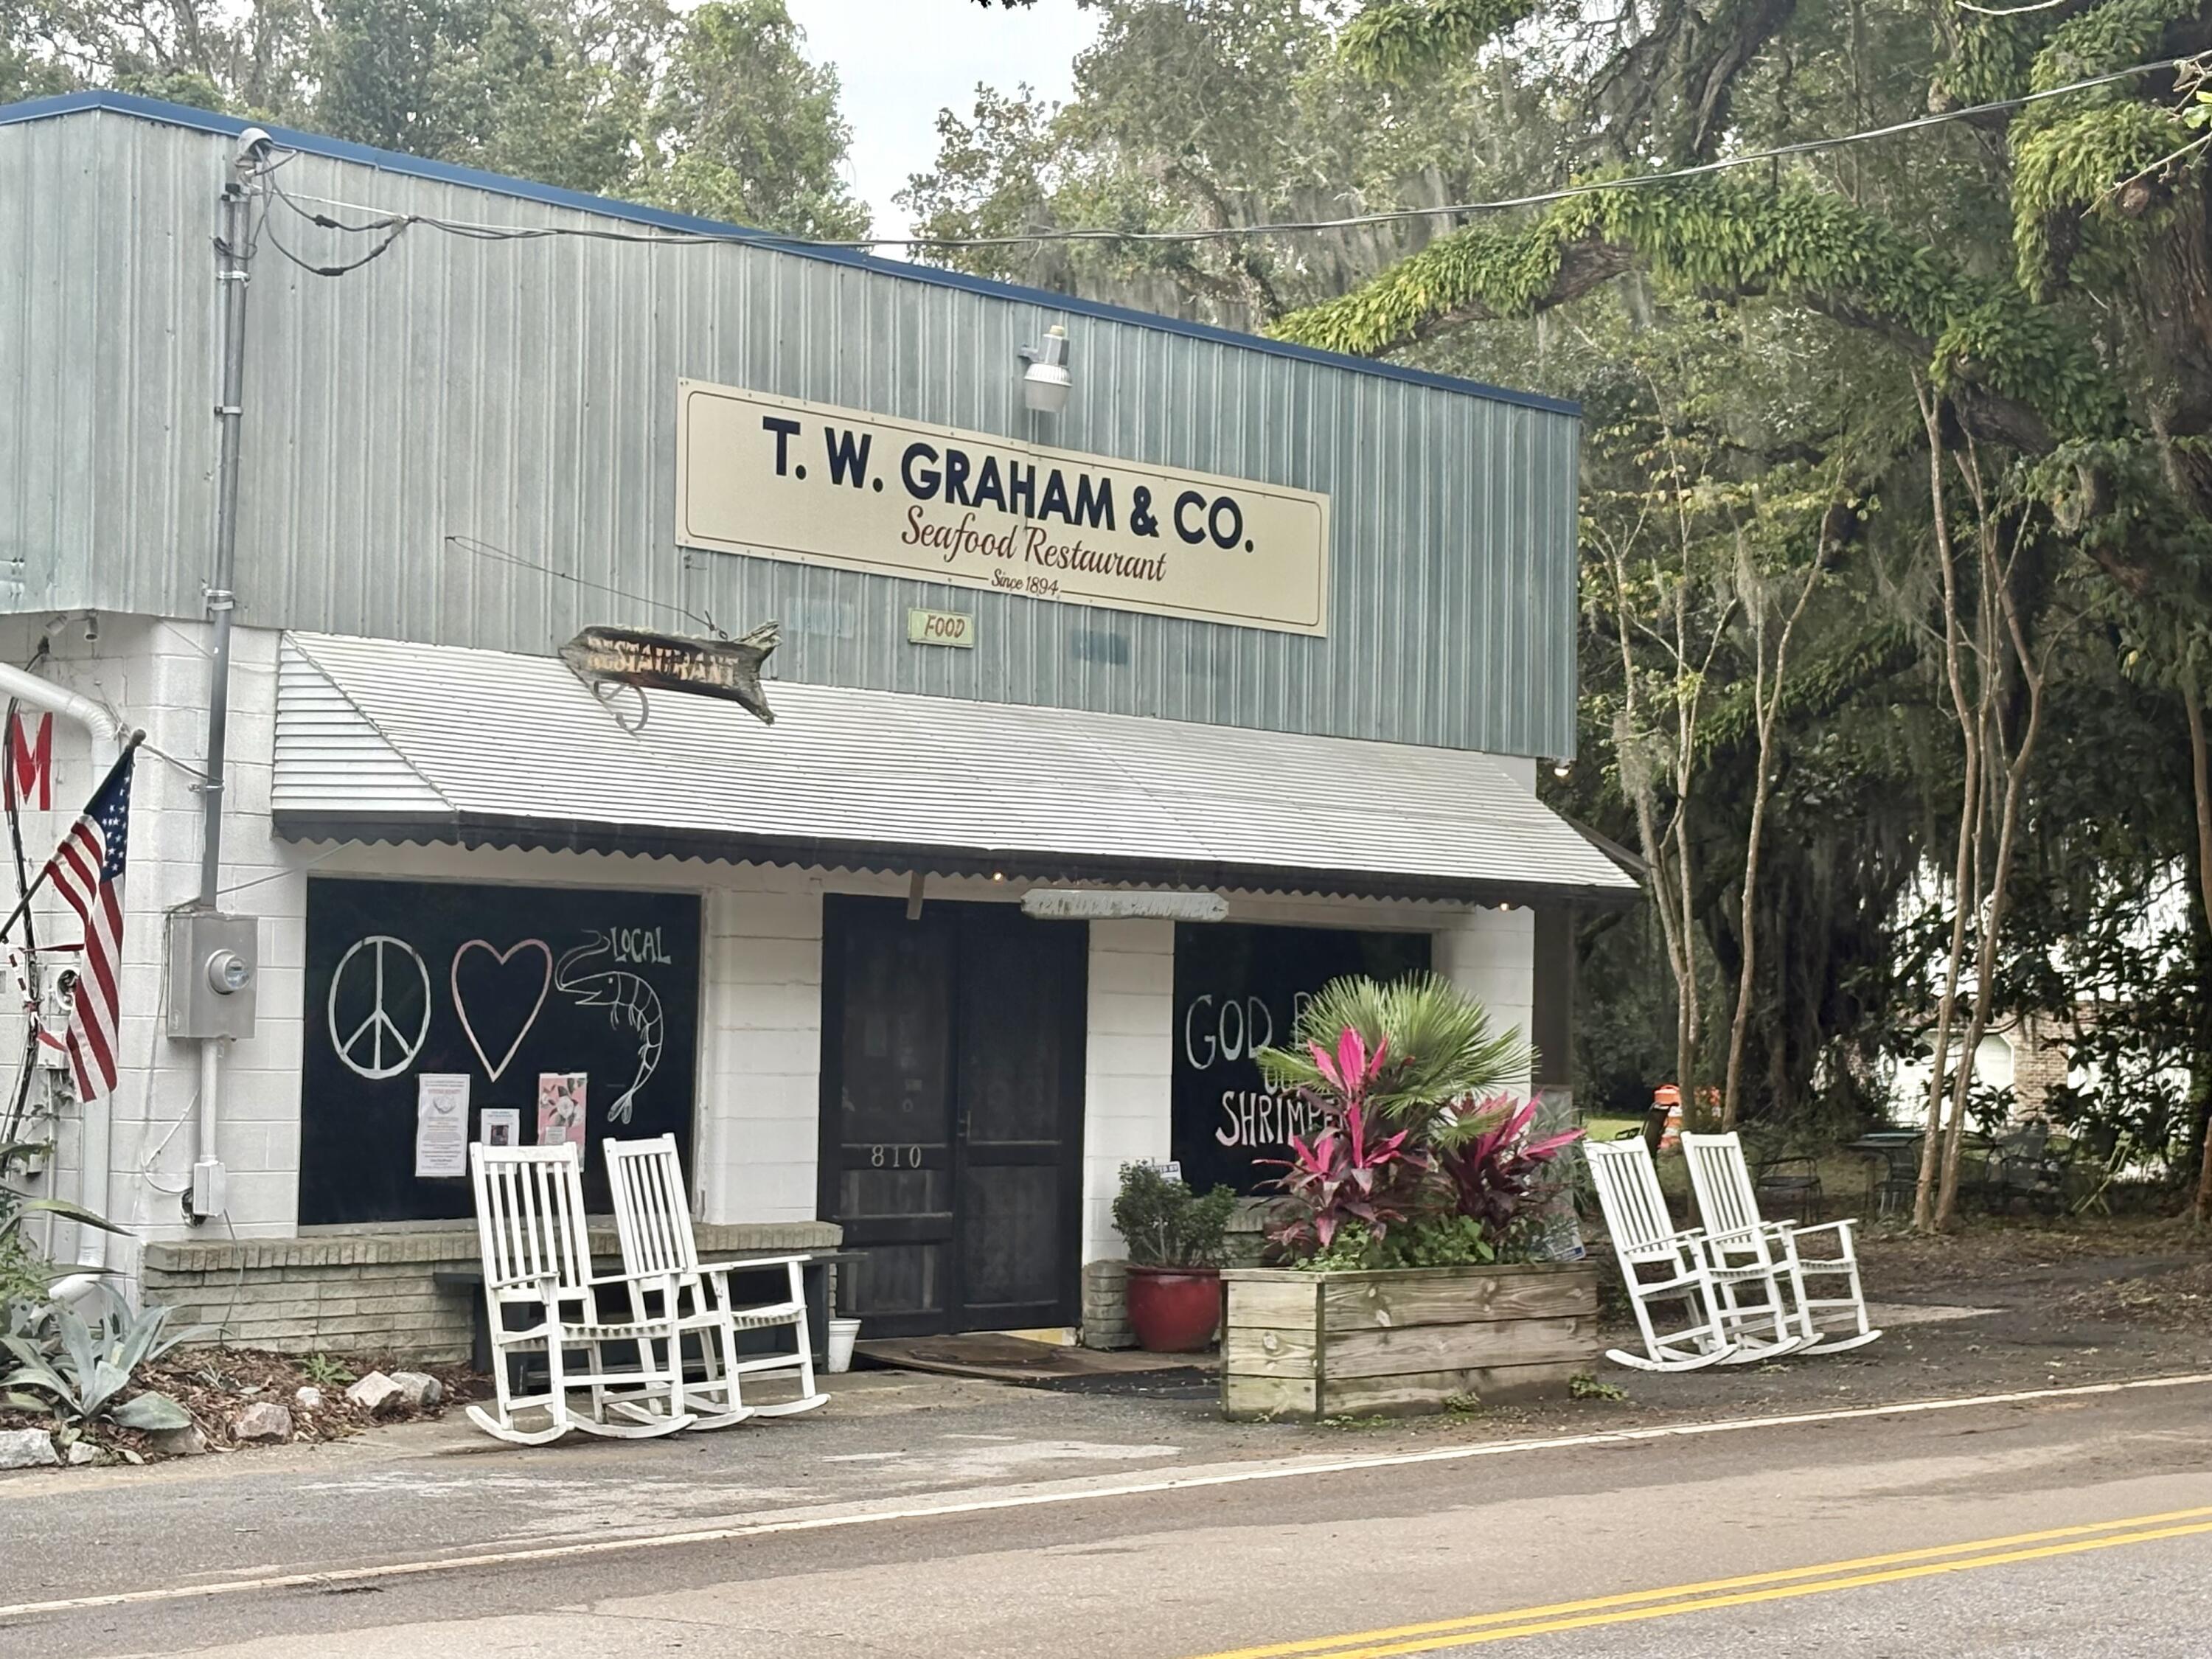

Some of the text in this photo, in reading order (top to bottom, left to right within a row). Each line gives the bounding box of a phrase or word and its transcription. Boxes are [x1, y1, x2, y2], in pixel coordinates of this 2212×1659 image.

[762, 415, 1253, 553] T. W. GRAHAM & CO.
[902, 505, 1167, 582] Seafood Restaurant
[992, 568, 1059, 596] Since 1894
[924, 614, 965, 639] FOOD
[587, 636, 740, 685] RESTAURANT
[610, 926, 672, 964] LOCAL
[1186, 994, 1273, 1069] GOD
[872, 1144, 921, 1168] 810
